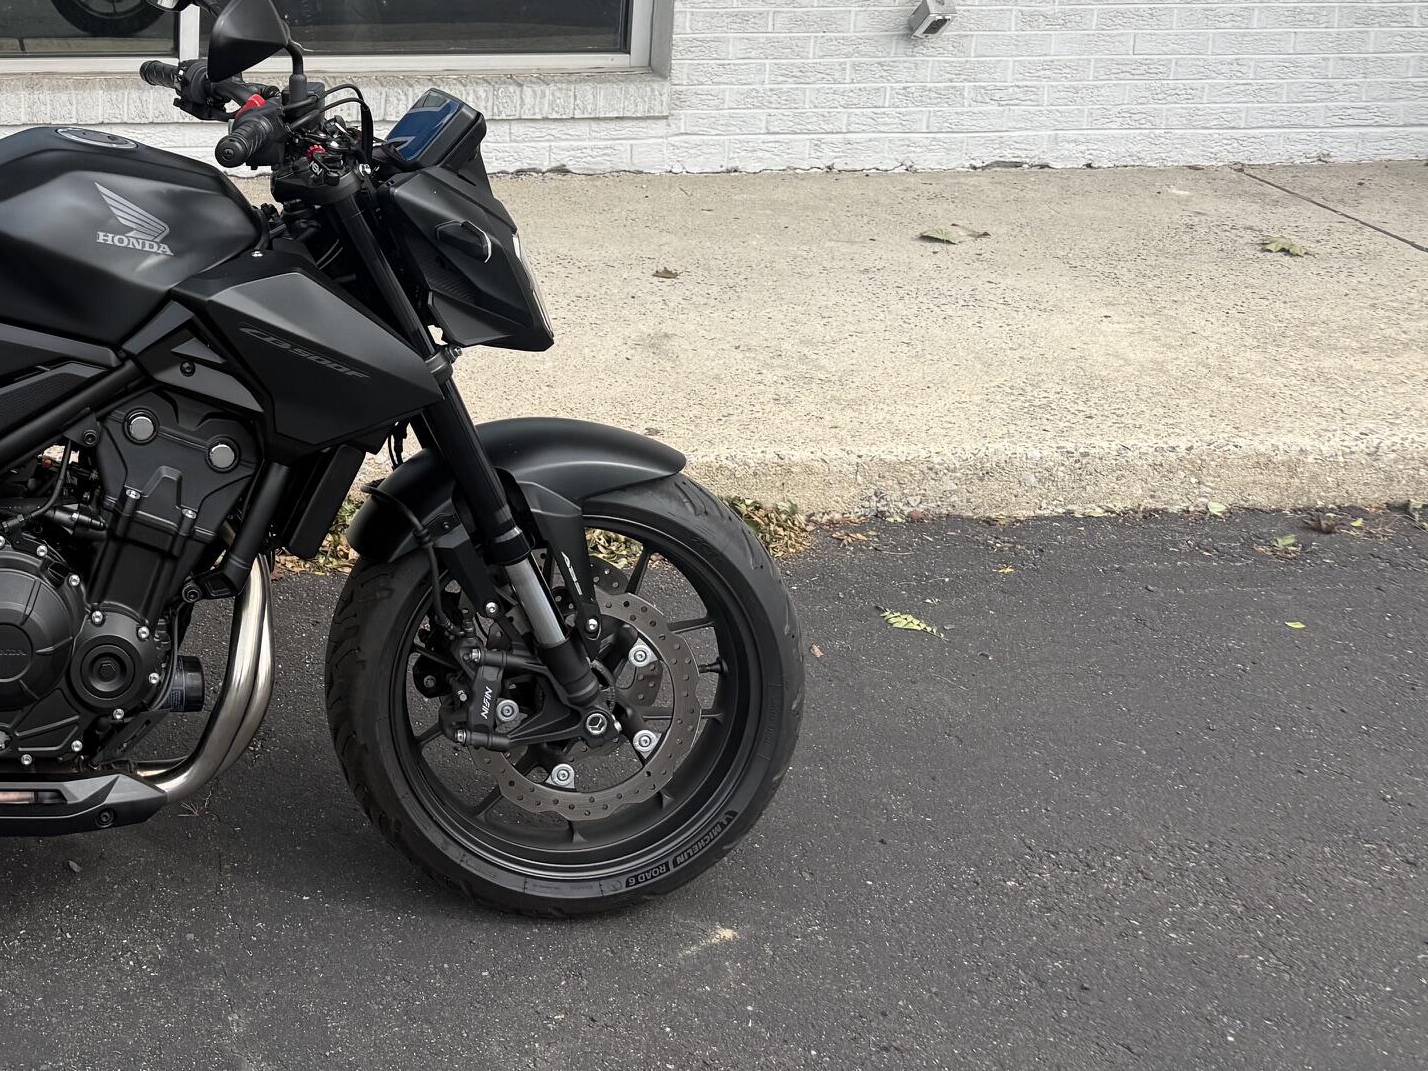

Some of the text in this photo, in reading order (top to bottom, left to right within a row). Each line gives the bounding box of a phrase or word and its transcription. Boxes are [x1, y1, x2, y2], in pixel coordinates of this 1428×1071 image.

[96, 231, 174, 256] HONDA
[676, 823, 722, 865] MICHELIN
[637, 863, 667, 882] ROAD
